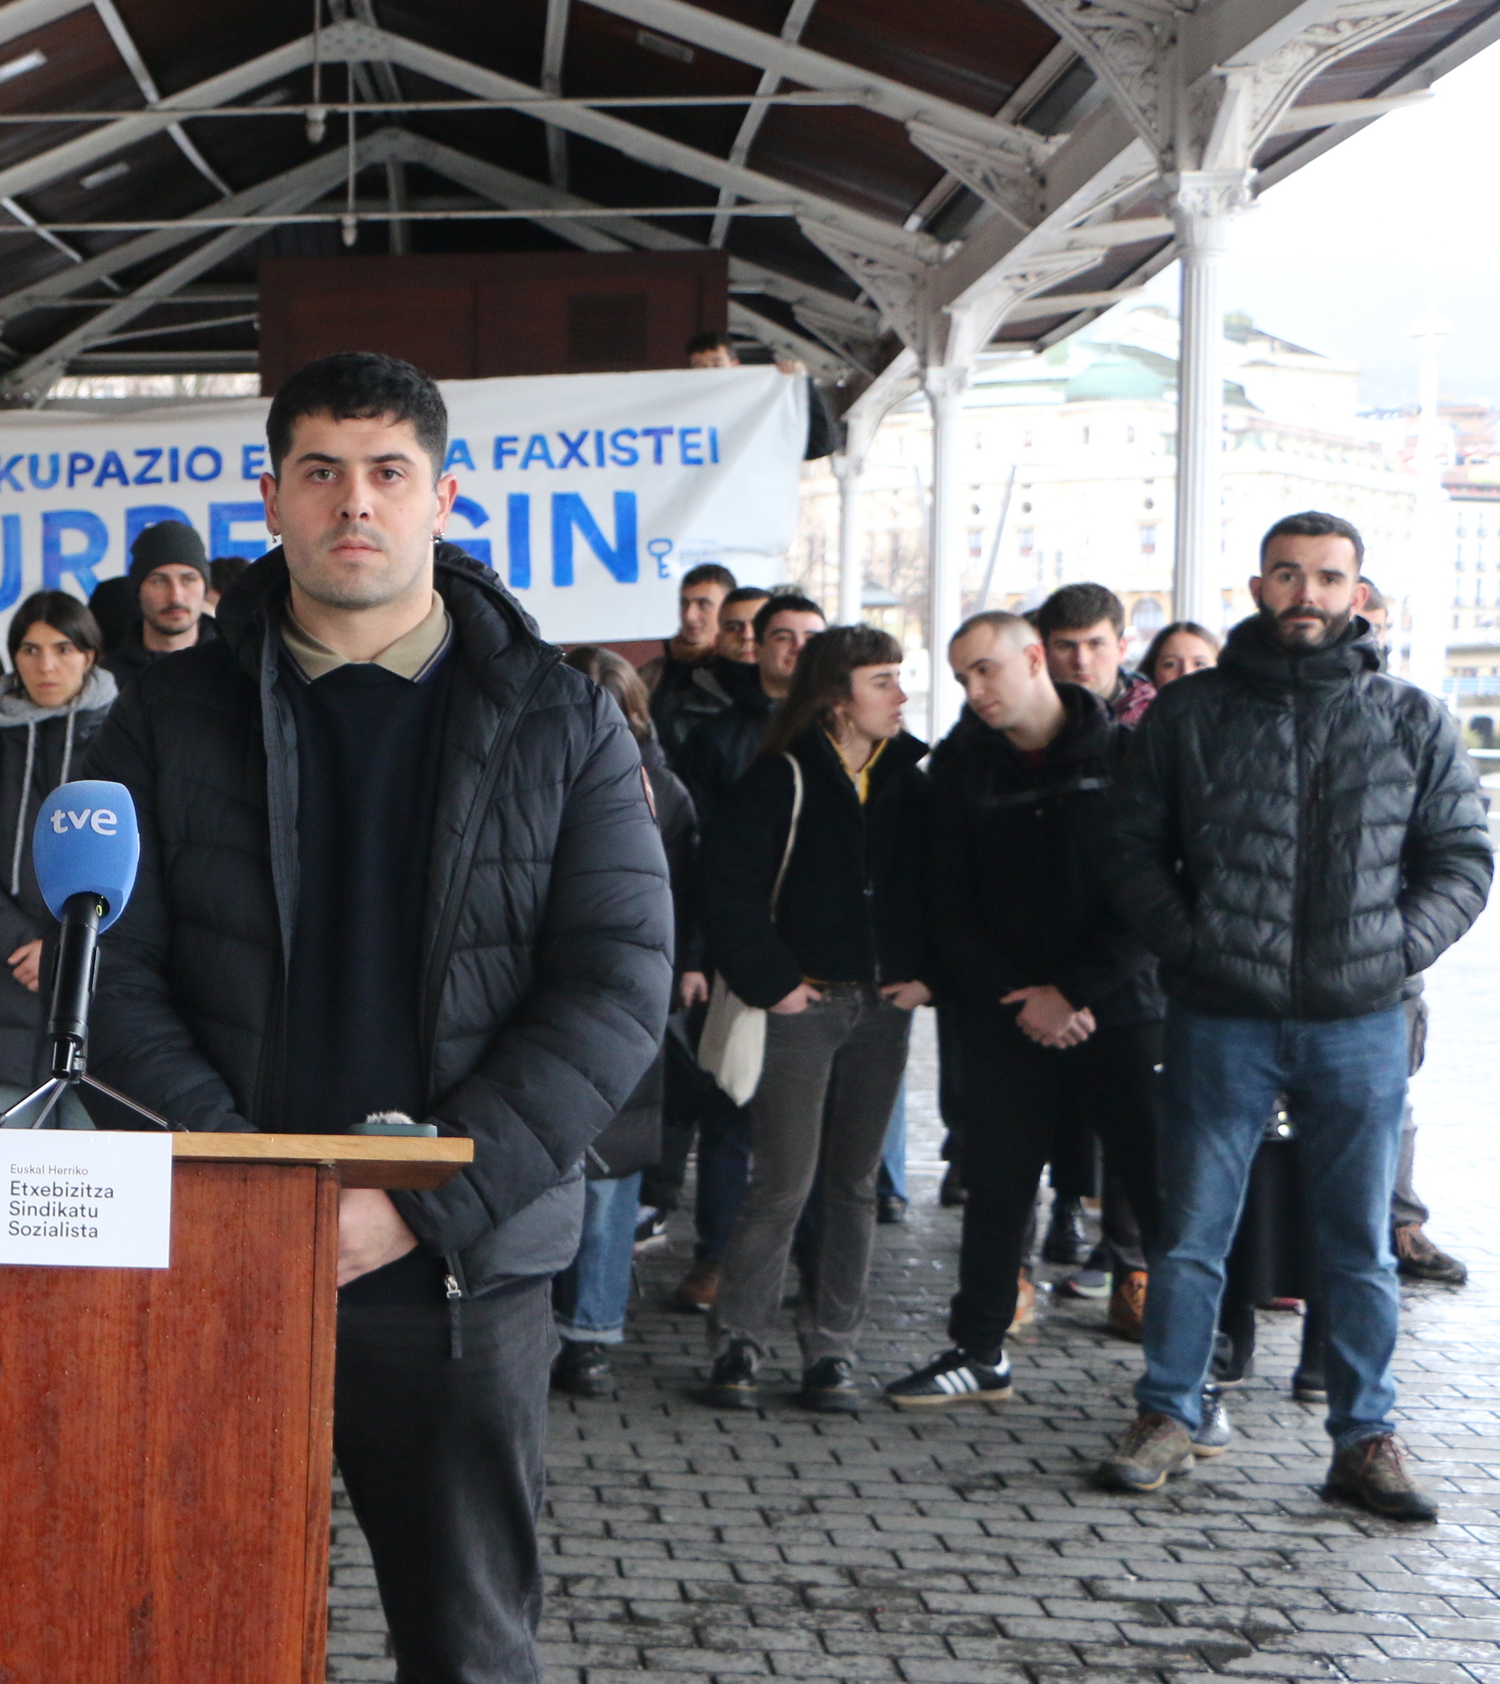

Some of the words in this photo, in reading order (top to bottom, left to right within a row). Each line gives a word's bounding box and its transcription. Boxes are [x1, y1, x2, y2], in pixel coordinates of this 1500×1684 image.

[493, 426, 720, 471] FAXISTEI
[50, 808, 118, 836] tve
[10, 1163, 45, 1175] Euskal
[48, 1164, 89, 1176] Herriko
[10, 1180, 114, 1199] Etxebizitza
[9, 1200, 98, 1218] Sindikatu
[8, 1220, 98, 1238] Sozialista
